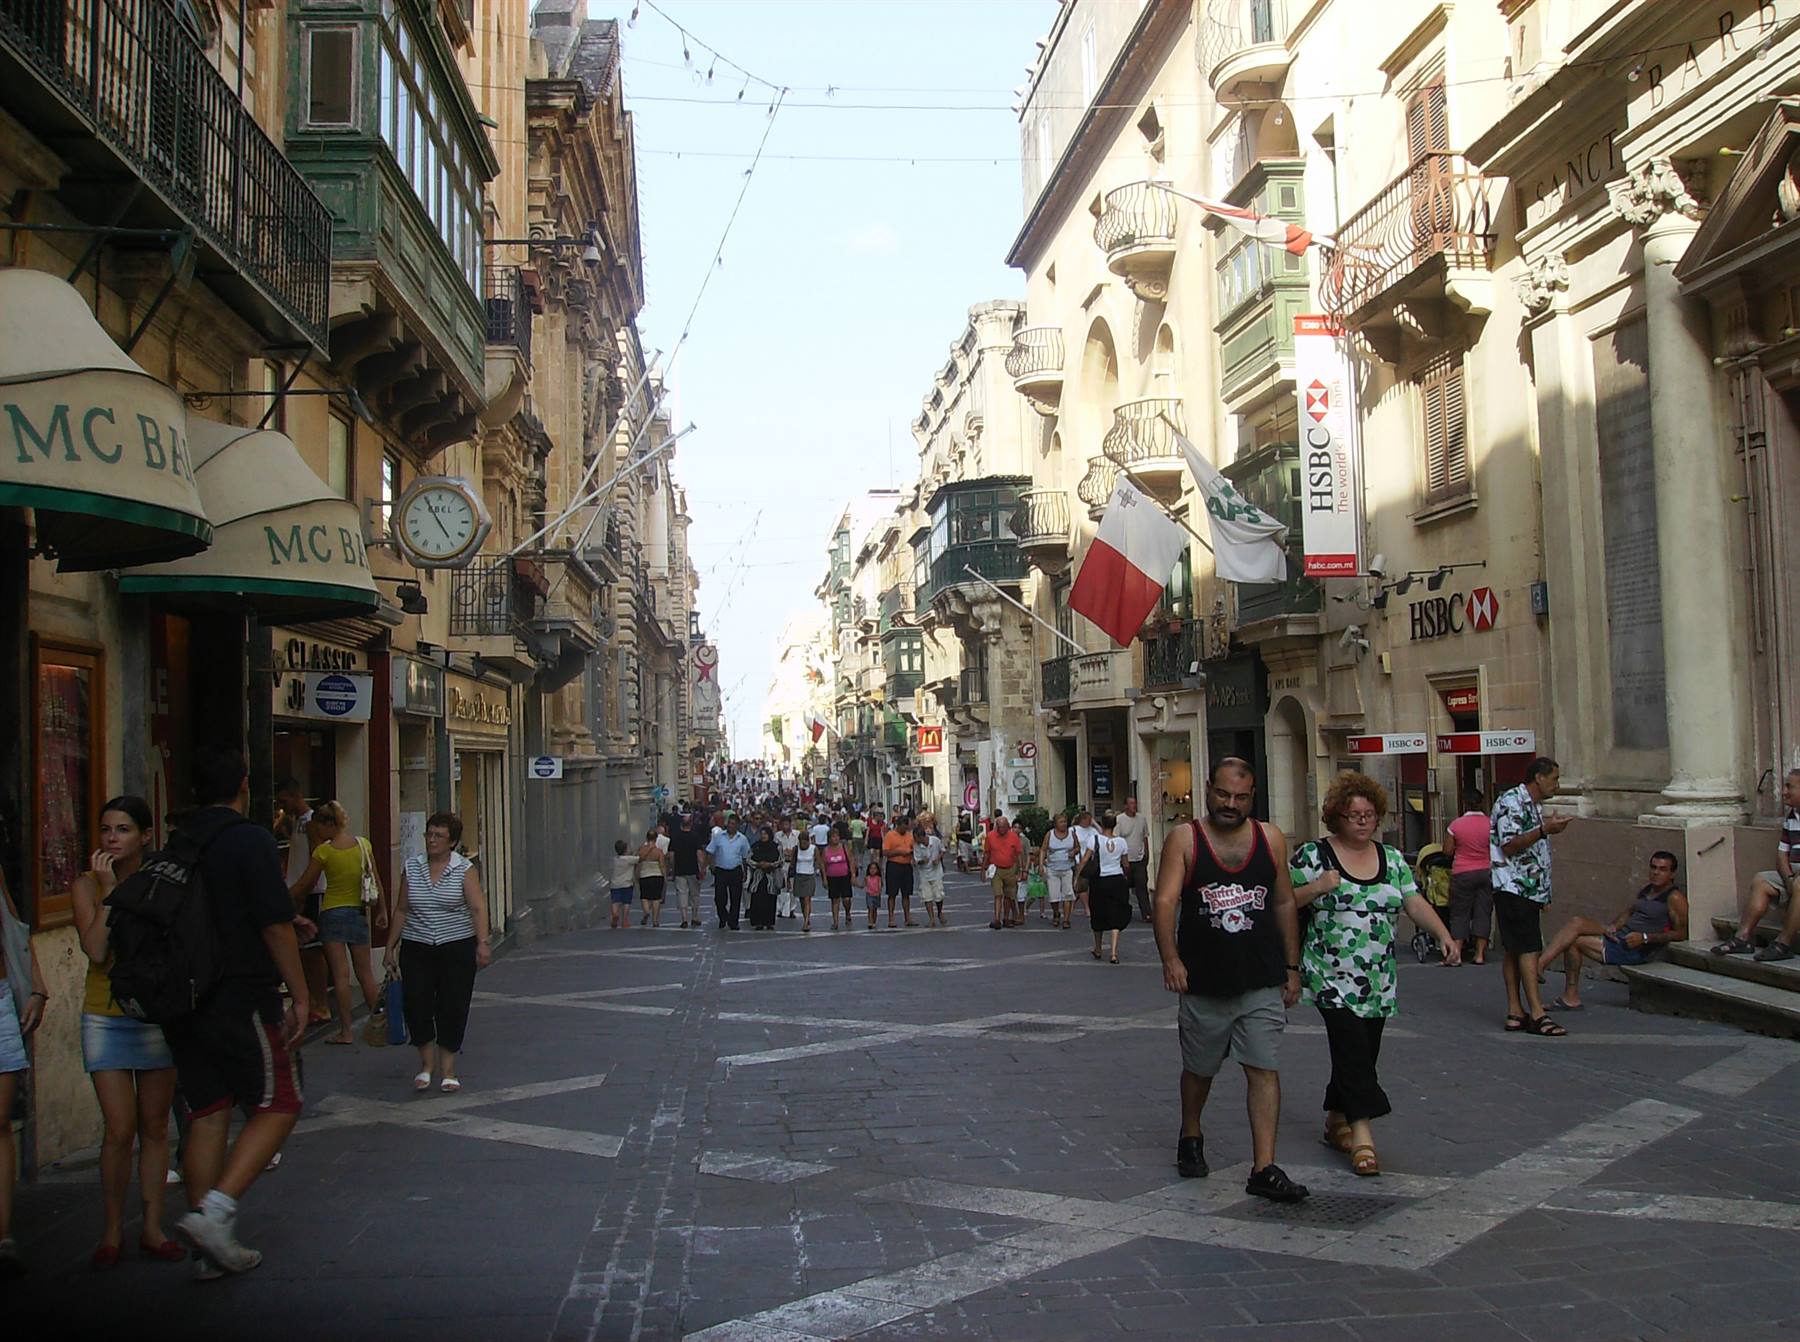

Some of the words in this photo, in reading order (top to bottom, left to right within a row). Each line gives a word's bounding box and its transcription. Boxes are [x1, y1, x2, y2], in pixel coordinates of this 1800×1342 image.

[4, 404, 123, 464] MC
[1307, 427, 1334, 514] HSBC
[1335, 443, 1347, 488] world's
[1207, 496, 1262, 523] APS
[1337, 492, 1349, 514] The
[264, 525, 332, 565] MC
[1308, 561, 1354, 569] hsbc.com.mt
[1409, 592, 1464, 640] HSBC
[287, 638, 357, 671] CLASSIC
[1447, 696, 1468, 708] Express
[1388, 739, 1411, 749] HSBC
[1486, 737, 1512, 747] HSBC
